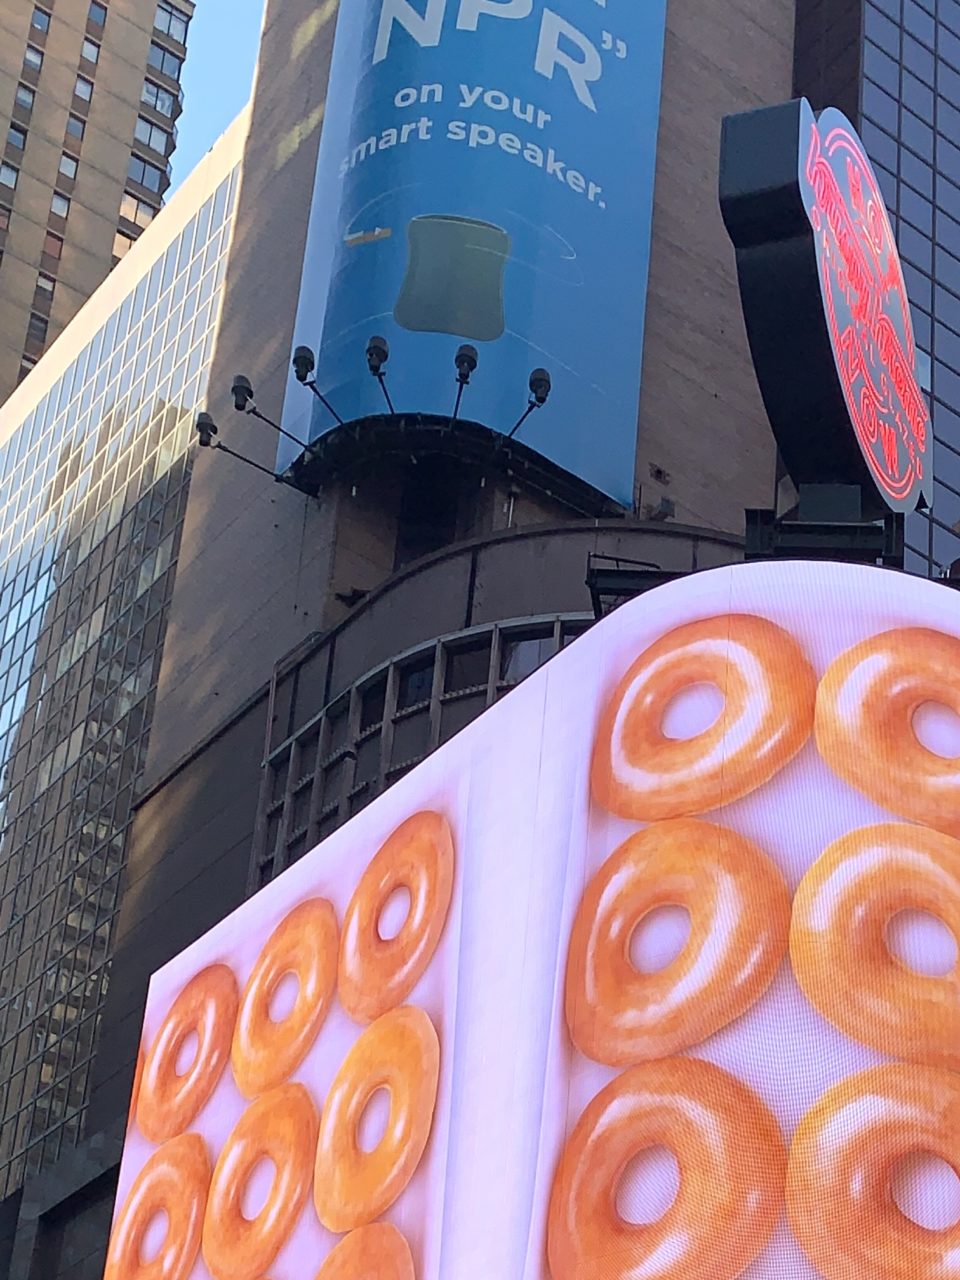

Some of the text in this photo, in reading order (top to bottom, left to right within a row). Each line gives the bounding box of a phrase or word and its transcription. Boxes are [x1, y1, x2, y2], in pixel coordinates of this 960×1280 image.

[394, 83, 551, 129] on your
[446, 119, 606, 209] speaker.
